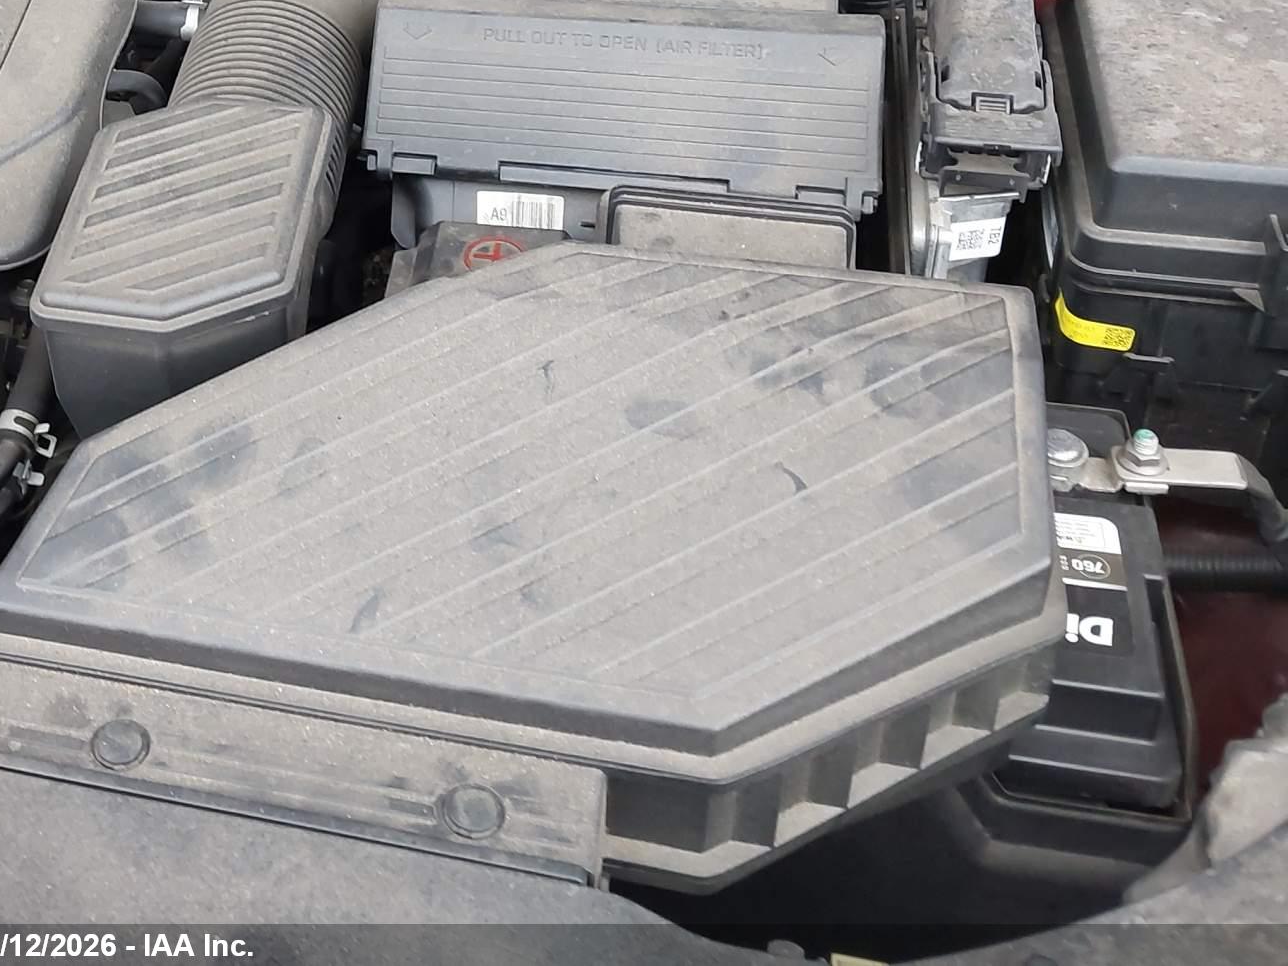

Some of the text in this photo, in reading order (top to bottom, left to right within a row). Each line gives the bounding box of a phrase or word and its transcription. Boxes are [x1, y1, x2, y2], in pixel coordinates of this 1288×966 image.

[483, 28, 526, 43] PULL
[531, 30, 567, 46] OUT
[571, 32, 593, 47] TO
[599, 34, 648, 51] OPEN
[1071, 557, 1105, 575] 760
